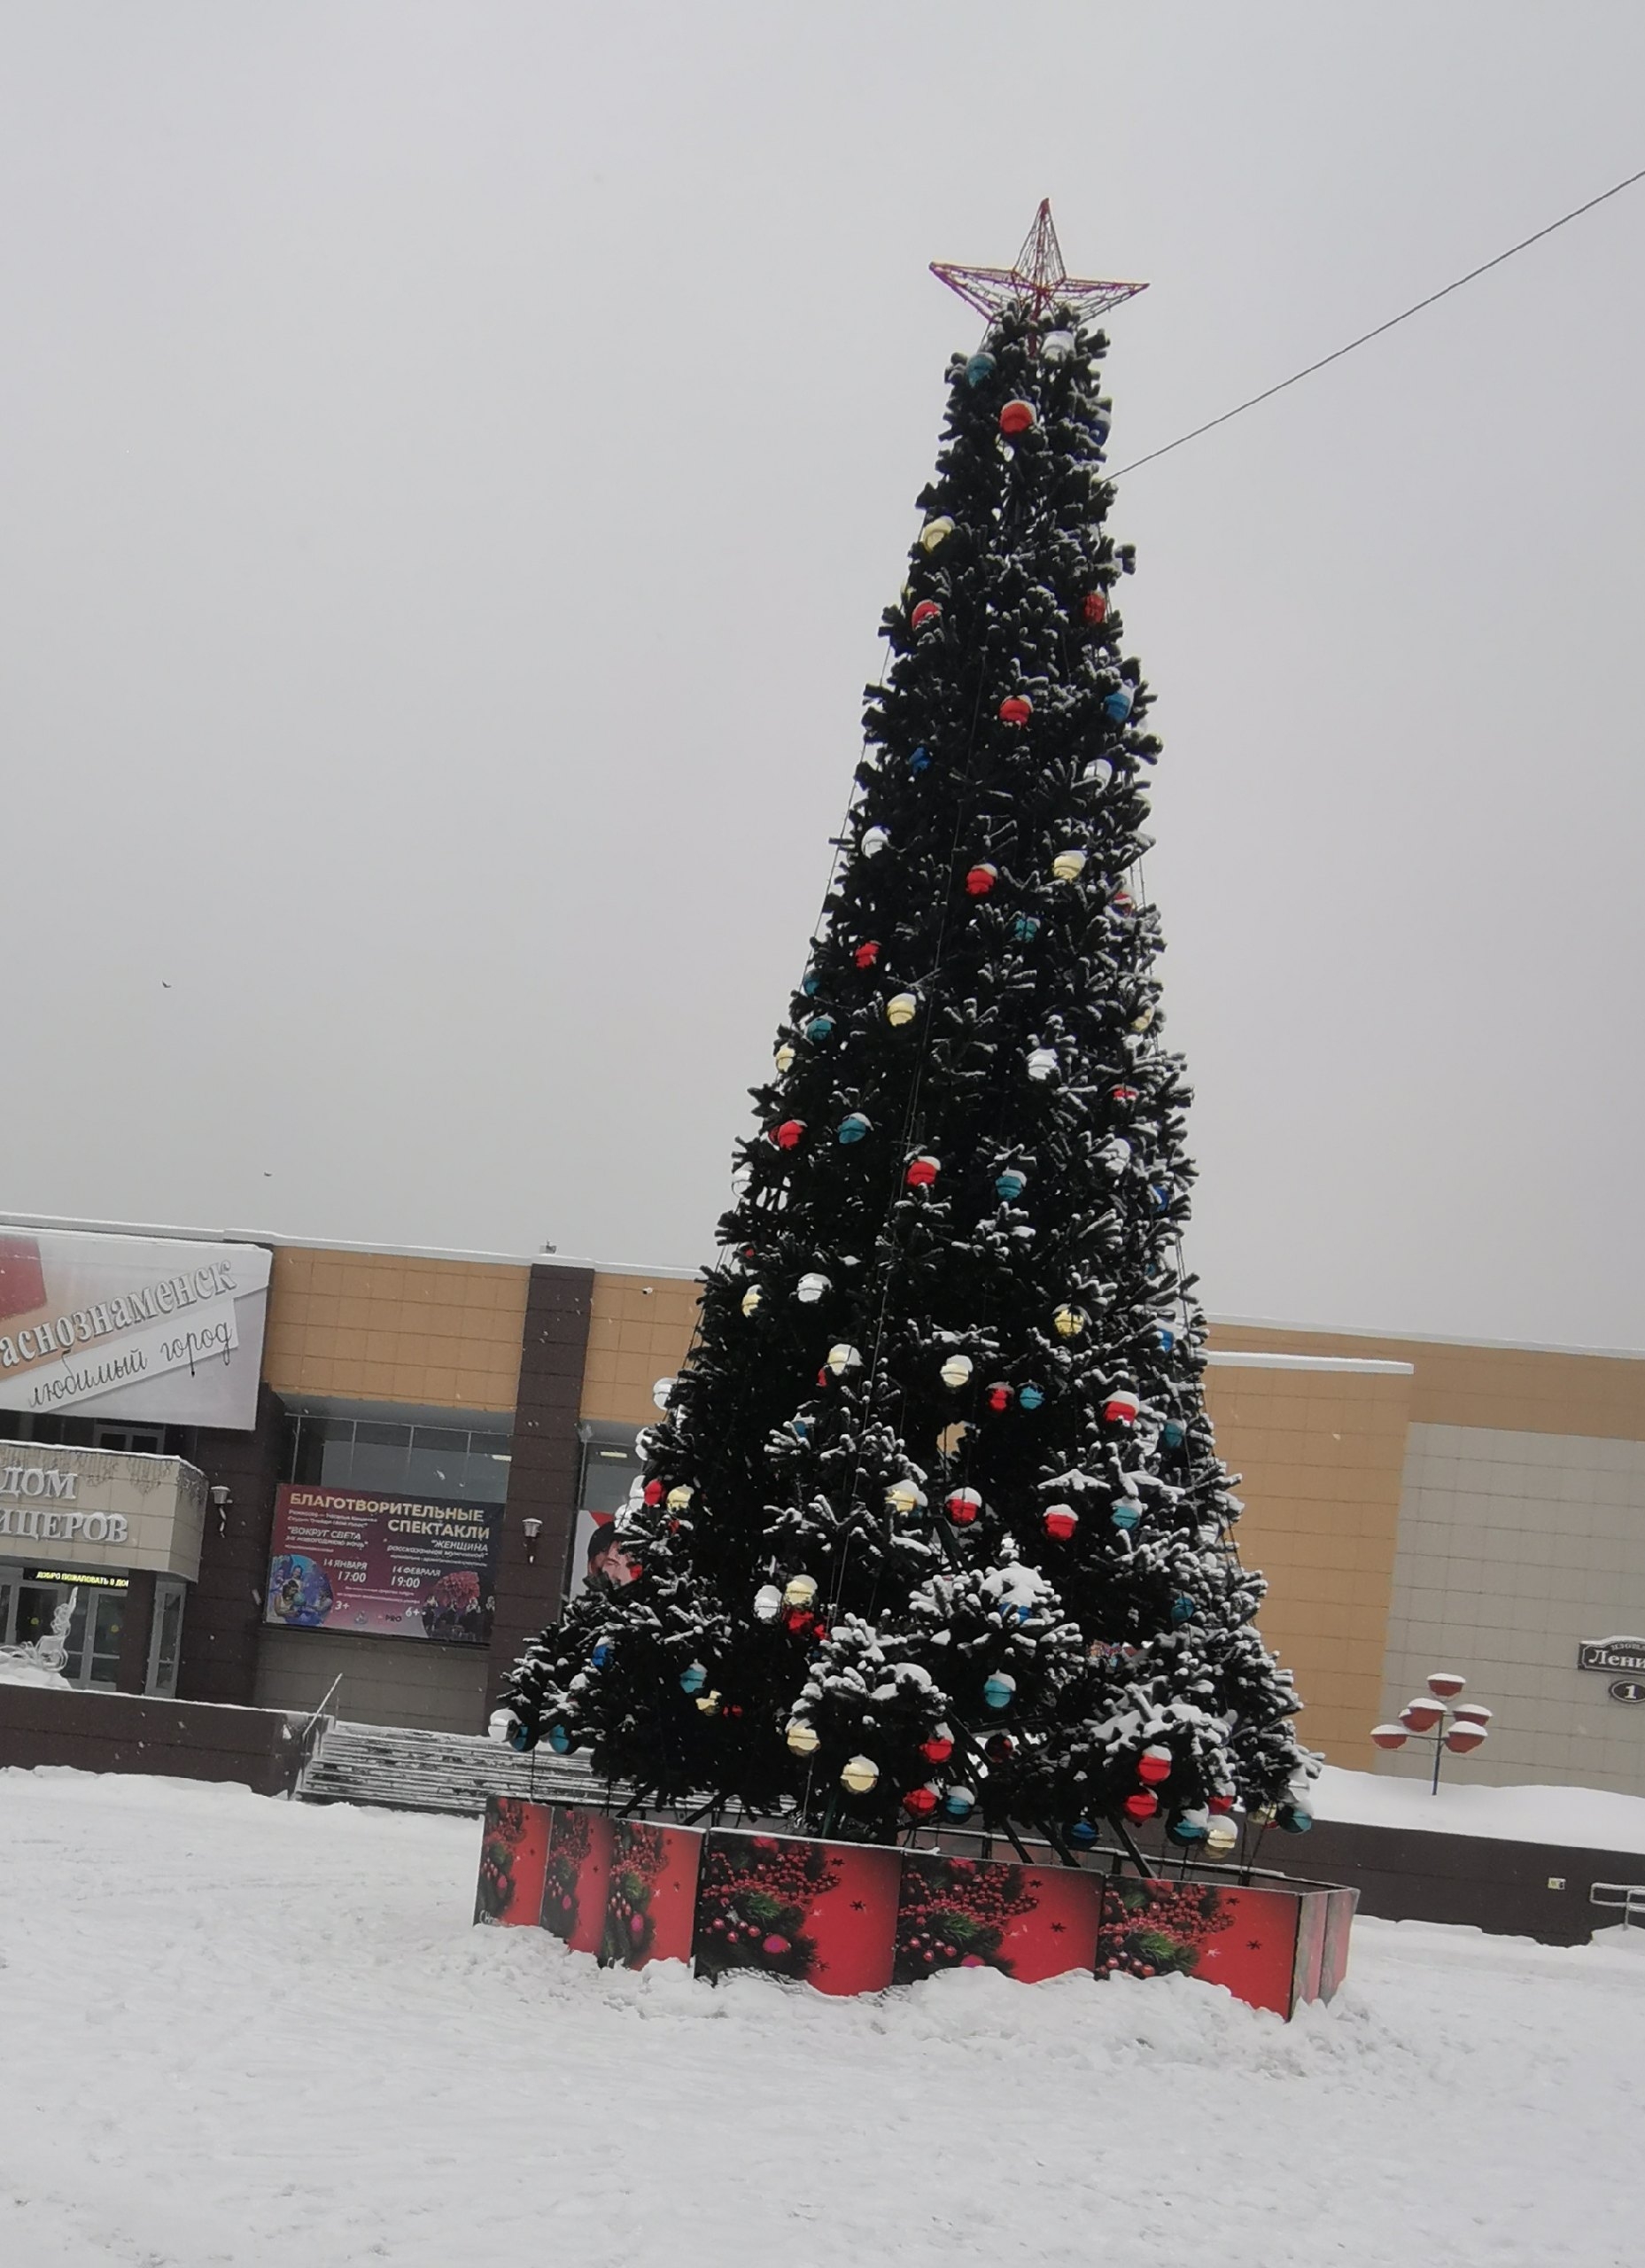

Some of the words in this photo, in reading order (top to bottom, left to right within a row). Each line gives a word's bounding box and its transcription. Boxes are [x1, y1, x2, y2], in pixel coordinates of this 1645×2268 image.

[29, 1348, 147, 1408] любимый
[160, 1322, 232, 1378] город
[0, 1467, 78, 1500] ДОМ
[290, 1492, 485, 1522] БЛАГОТВОРИТЕЛЬНЫЕ
[330, 1530, 361, 1540] СВЕТА
[387, 1519, 490, 1539] СПЕКТАКЛИ
[333, 1559, 369, 1571] ЯНВАРЯ
[338, 1571, 367, 1583] 17:00
[403, 1566, 441, 1577] ФЕВРАЛЯ
[391, 1576, 421, 1588] 19:00
[335, 1600, 350, 1611] 3+
[405, 1607, 421, 1617] 6+
[1625, 1685, 1636, 1699] 1
